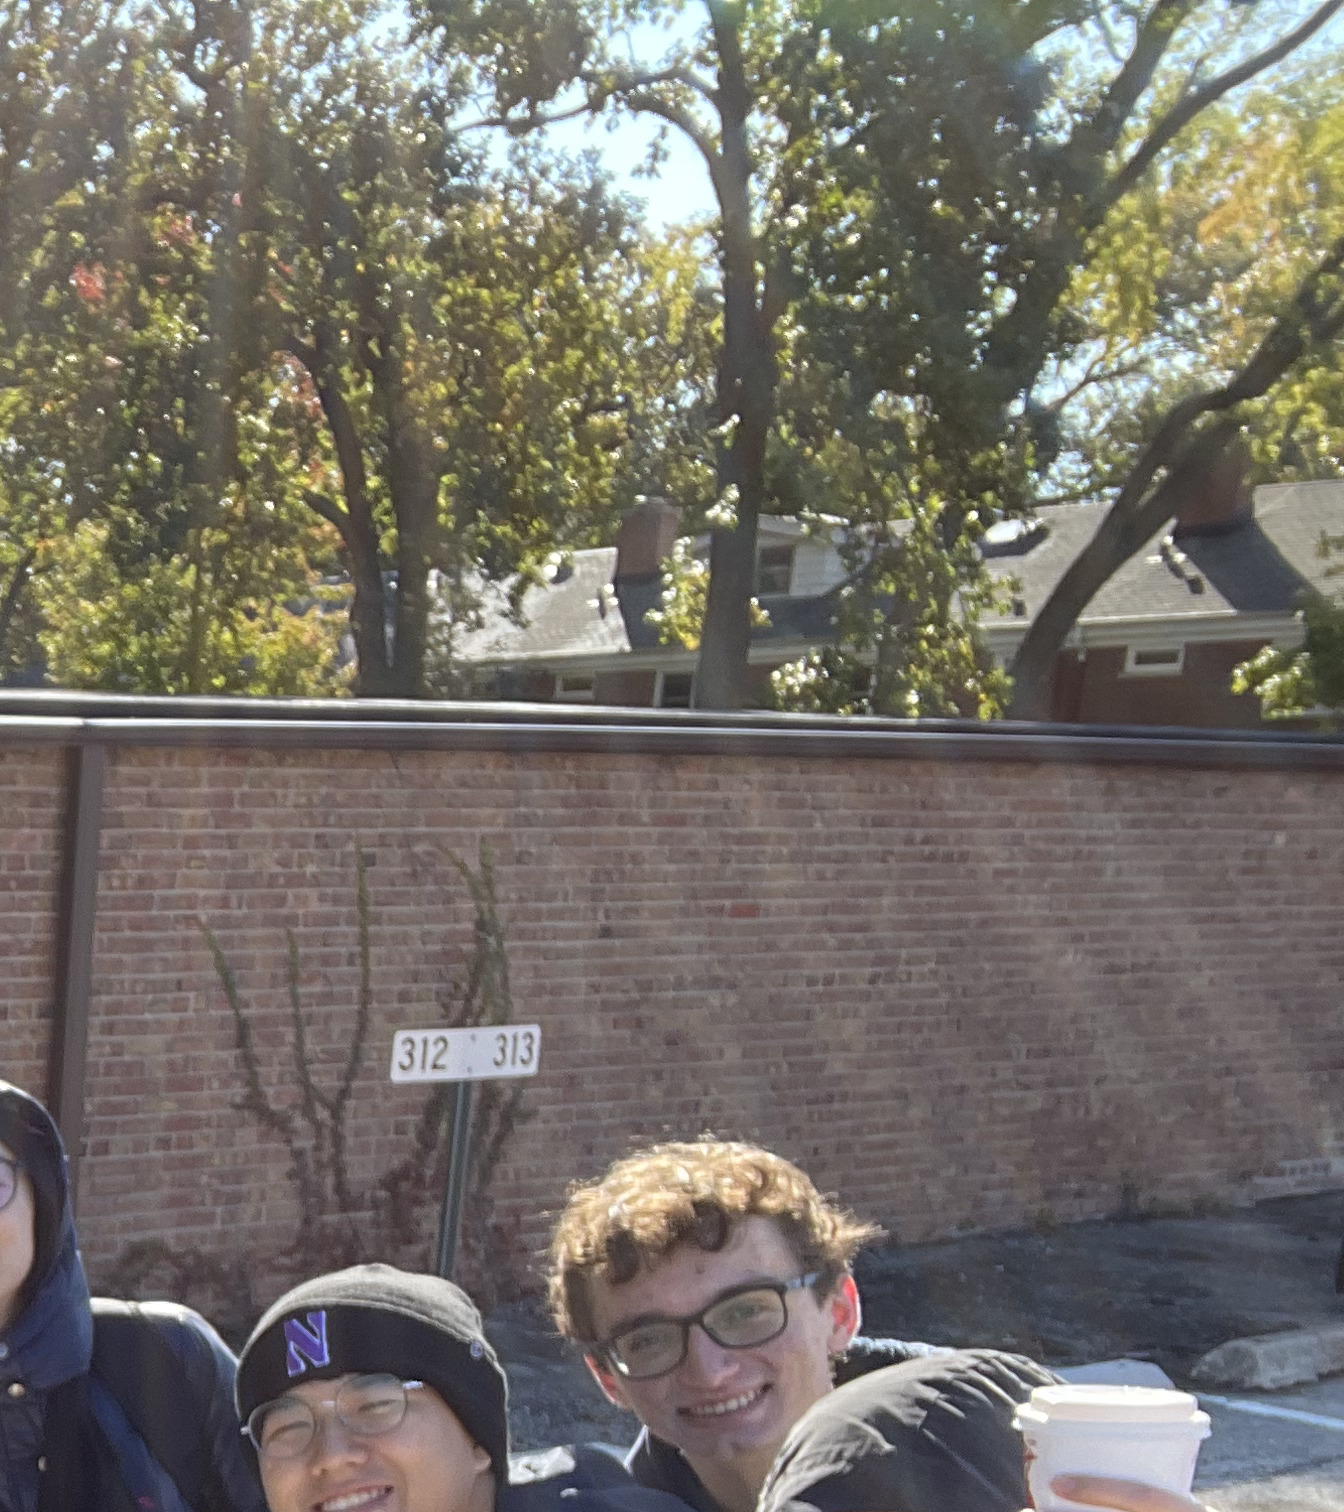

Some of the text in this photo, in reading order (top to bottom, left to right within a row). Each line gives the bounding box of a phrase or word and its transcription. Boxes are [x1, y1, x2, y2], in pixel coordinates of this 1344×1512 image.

[398, 1031, 535, 1073] 312 313
[284, 1310, 330, 1377] N
